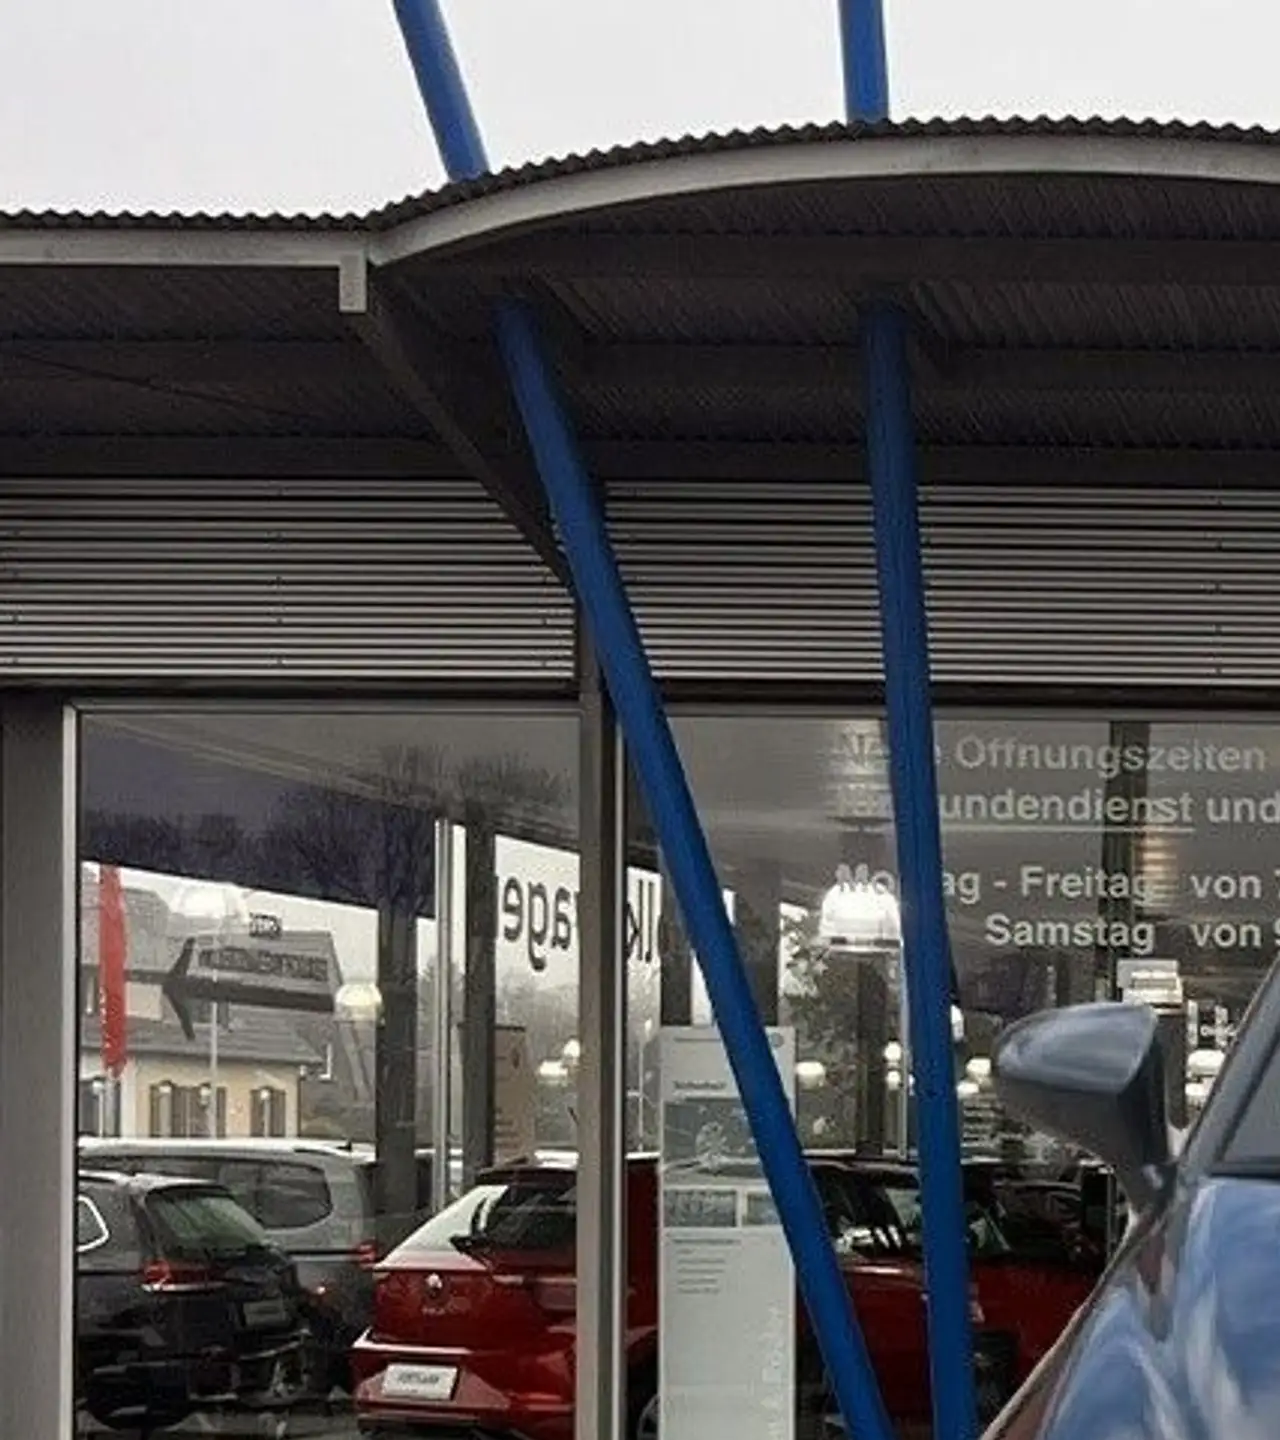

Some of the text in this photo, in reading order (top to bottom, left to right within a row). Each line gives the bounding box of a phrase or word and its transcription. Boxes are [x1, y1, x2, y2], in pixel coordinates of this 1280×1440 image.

[937, 789, 1193, 824] undendienst
[1020, 865, 1154, 905] Freitag
[1190, 874, 1262, 899] von
[985, 913, 1155, 955] Samstag
[1190, 923, 1262, 948] von
